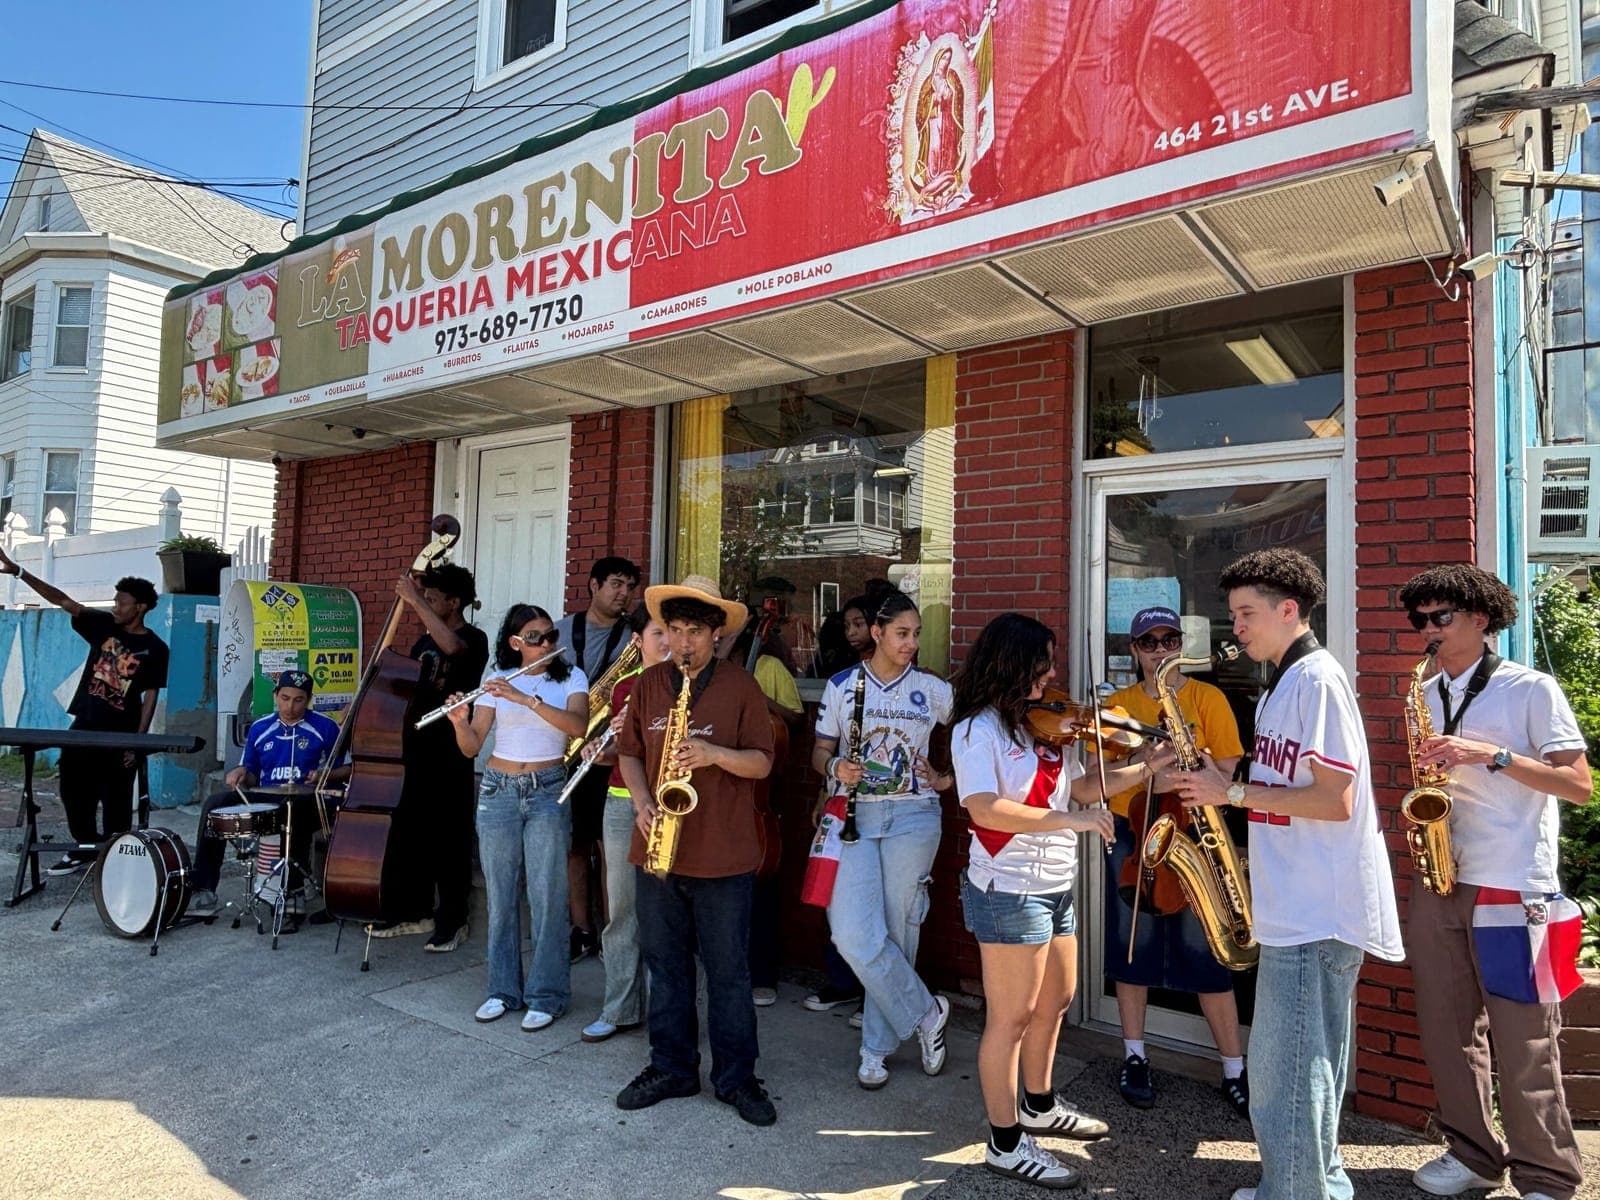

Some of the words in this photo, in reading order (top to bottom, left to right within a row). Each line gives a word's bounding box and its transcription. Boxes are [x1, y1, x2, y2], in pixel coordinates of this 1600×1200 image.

[1153, 122, 1202, 151] 464
[1211, 103, 1273, 136] 21st
[1282, 79, 1359, 117] AVE.
[296, 258, 367, 327] LA
[378, 88, 803, 301] MORENITA
[335, 276, 495, 351] TAQUERIA
[506, 193, 747, 303] MEXICANA
[745, 276, 774, 295] MOLE
[777, 262, 833, 287] POBLANO
[646, 296, 708, 320] CAMARONES
[434, 294, 583, 354] 973-689-7730
[567, 320, 614, 340] HOJARRAS
[507, 339, 539, 354] FLAUTAS
[447, 352, 482, 368] BURRITOS
[386, 366, 424, 383] HUARACHES
[328, 380, 366, 396] QUESADILLAS
[293, 393, 311, 404] TACOS
[315, 653, 353, 665] ATM
[271, 766, 301, 780] CUBA
[124, 844, 146, 857] TAMA
